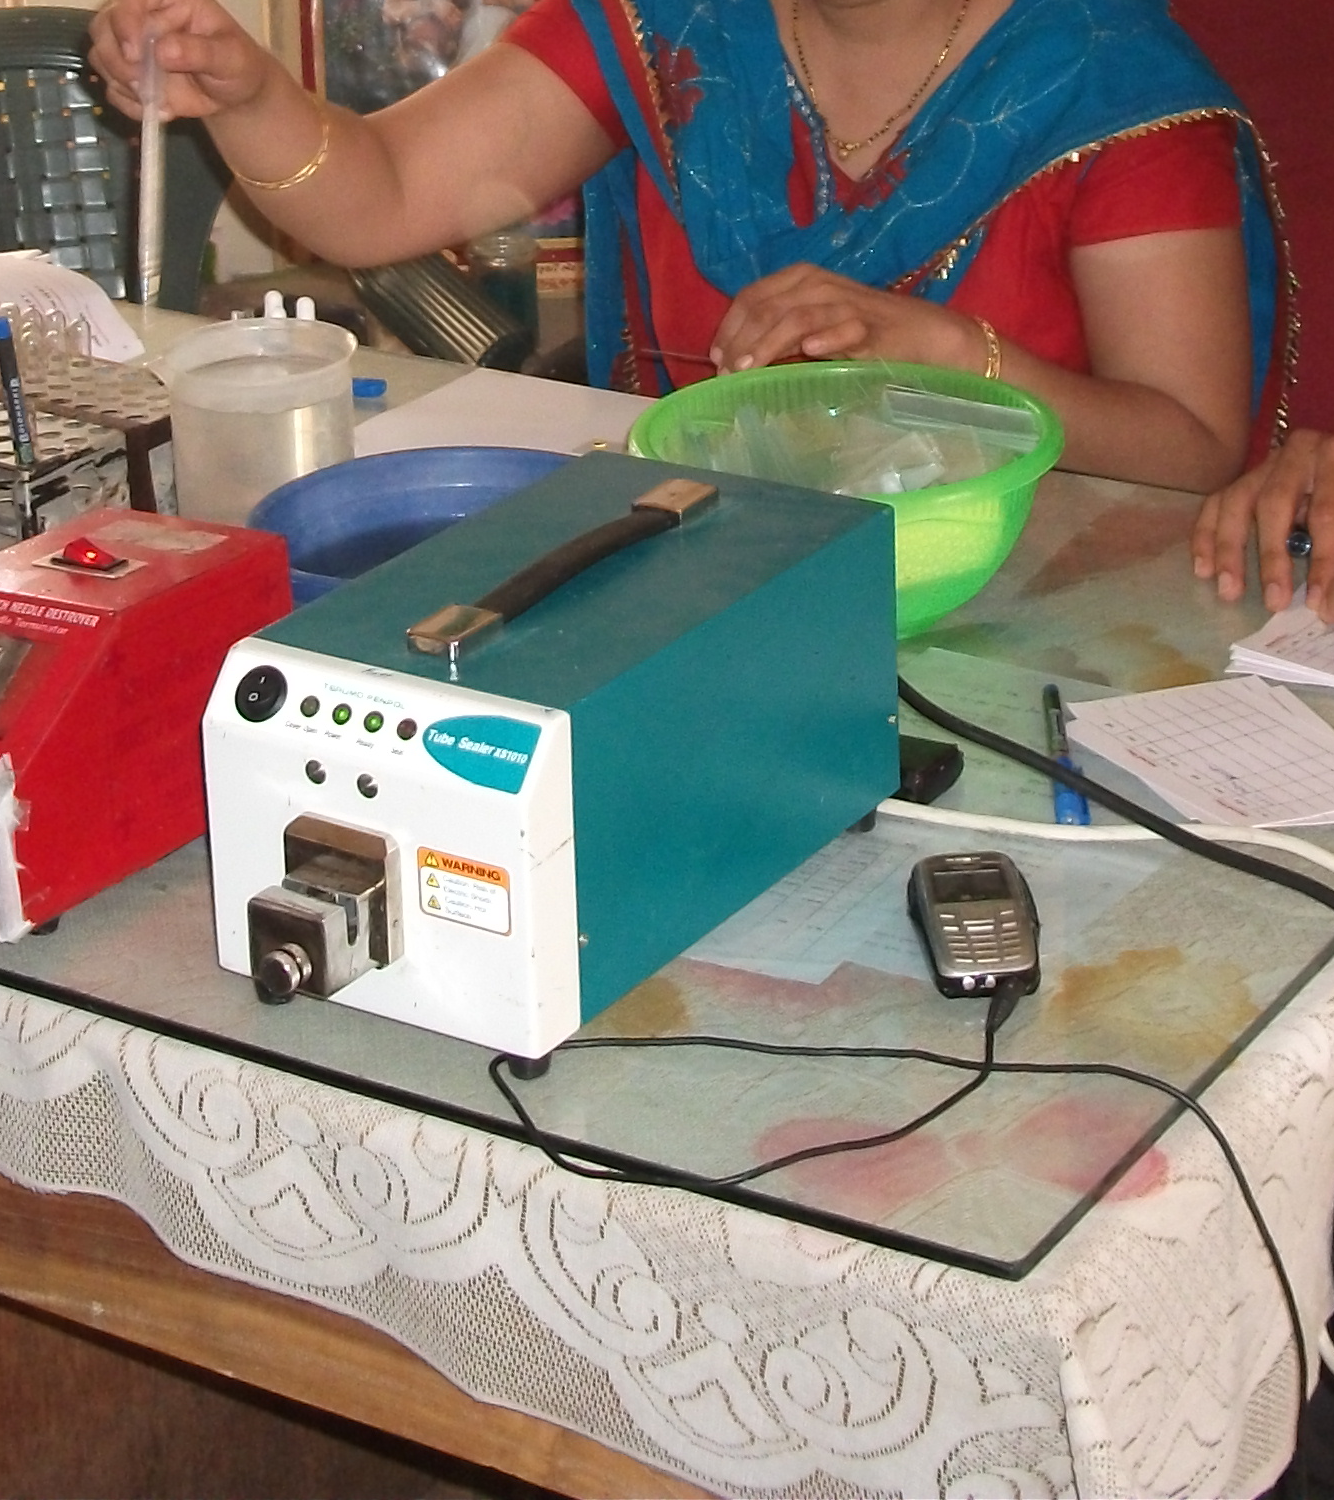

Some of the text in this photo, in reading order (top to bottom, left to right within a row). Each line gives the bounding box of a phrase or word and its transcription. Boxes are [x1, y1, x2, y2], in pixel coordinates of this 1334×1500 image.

[9, 602, 46, 617] NEEDLE
[44, 606, 101, 628] DESTROYER
[428, 729, 456, 746] Tube
[458, 736, 495, 754] Sealer
[442, 858, 501, 881] WARNING
